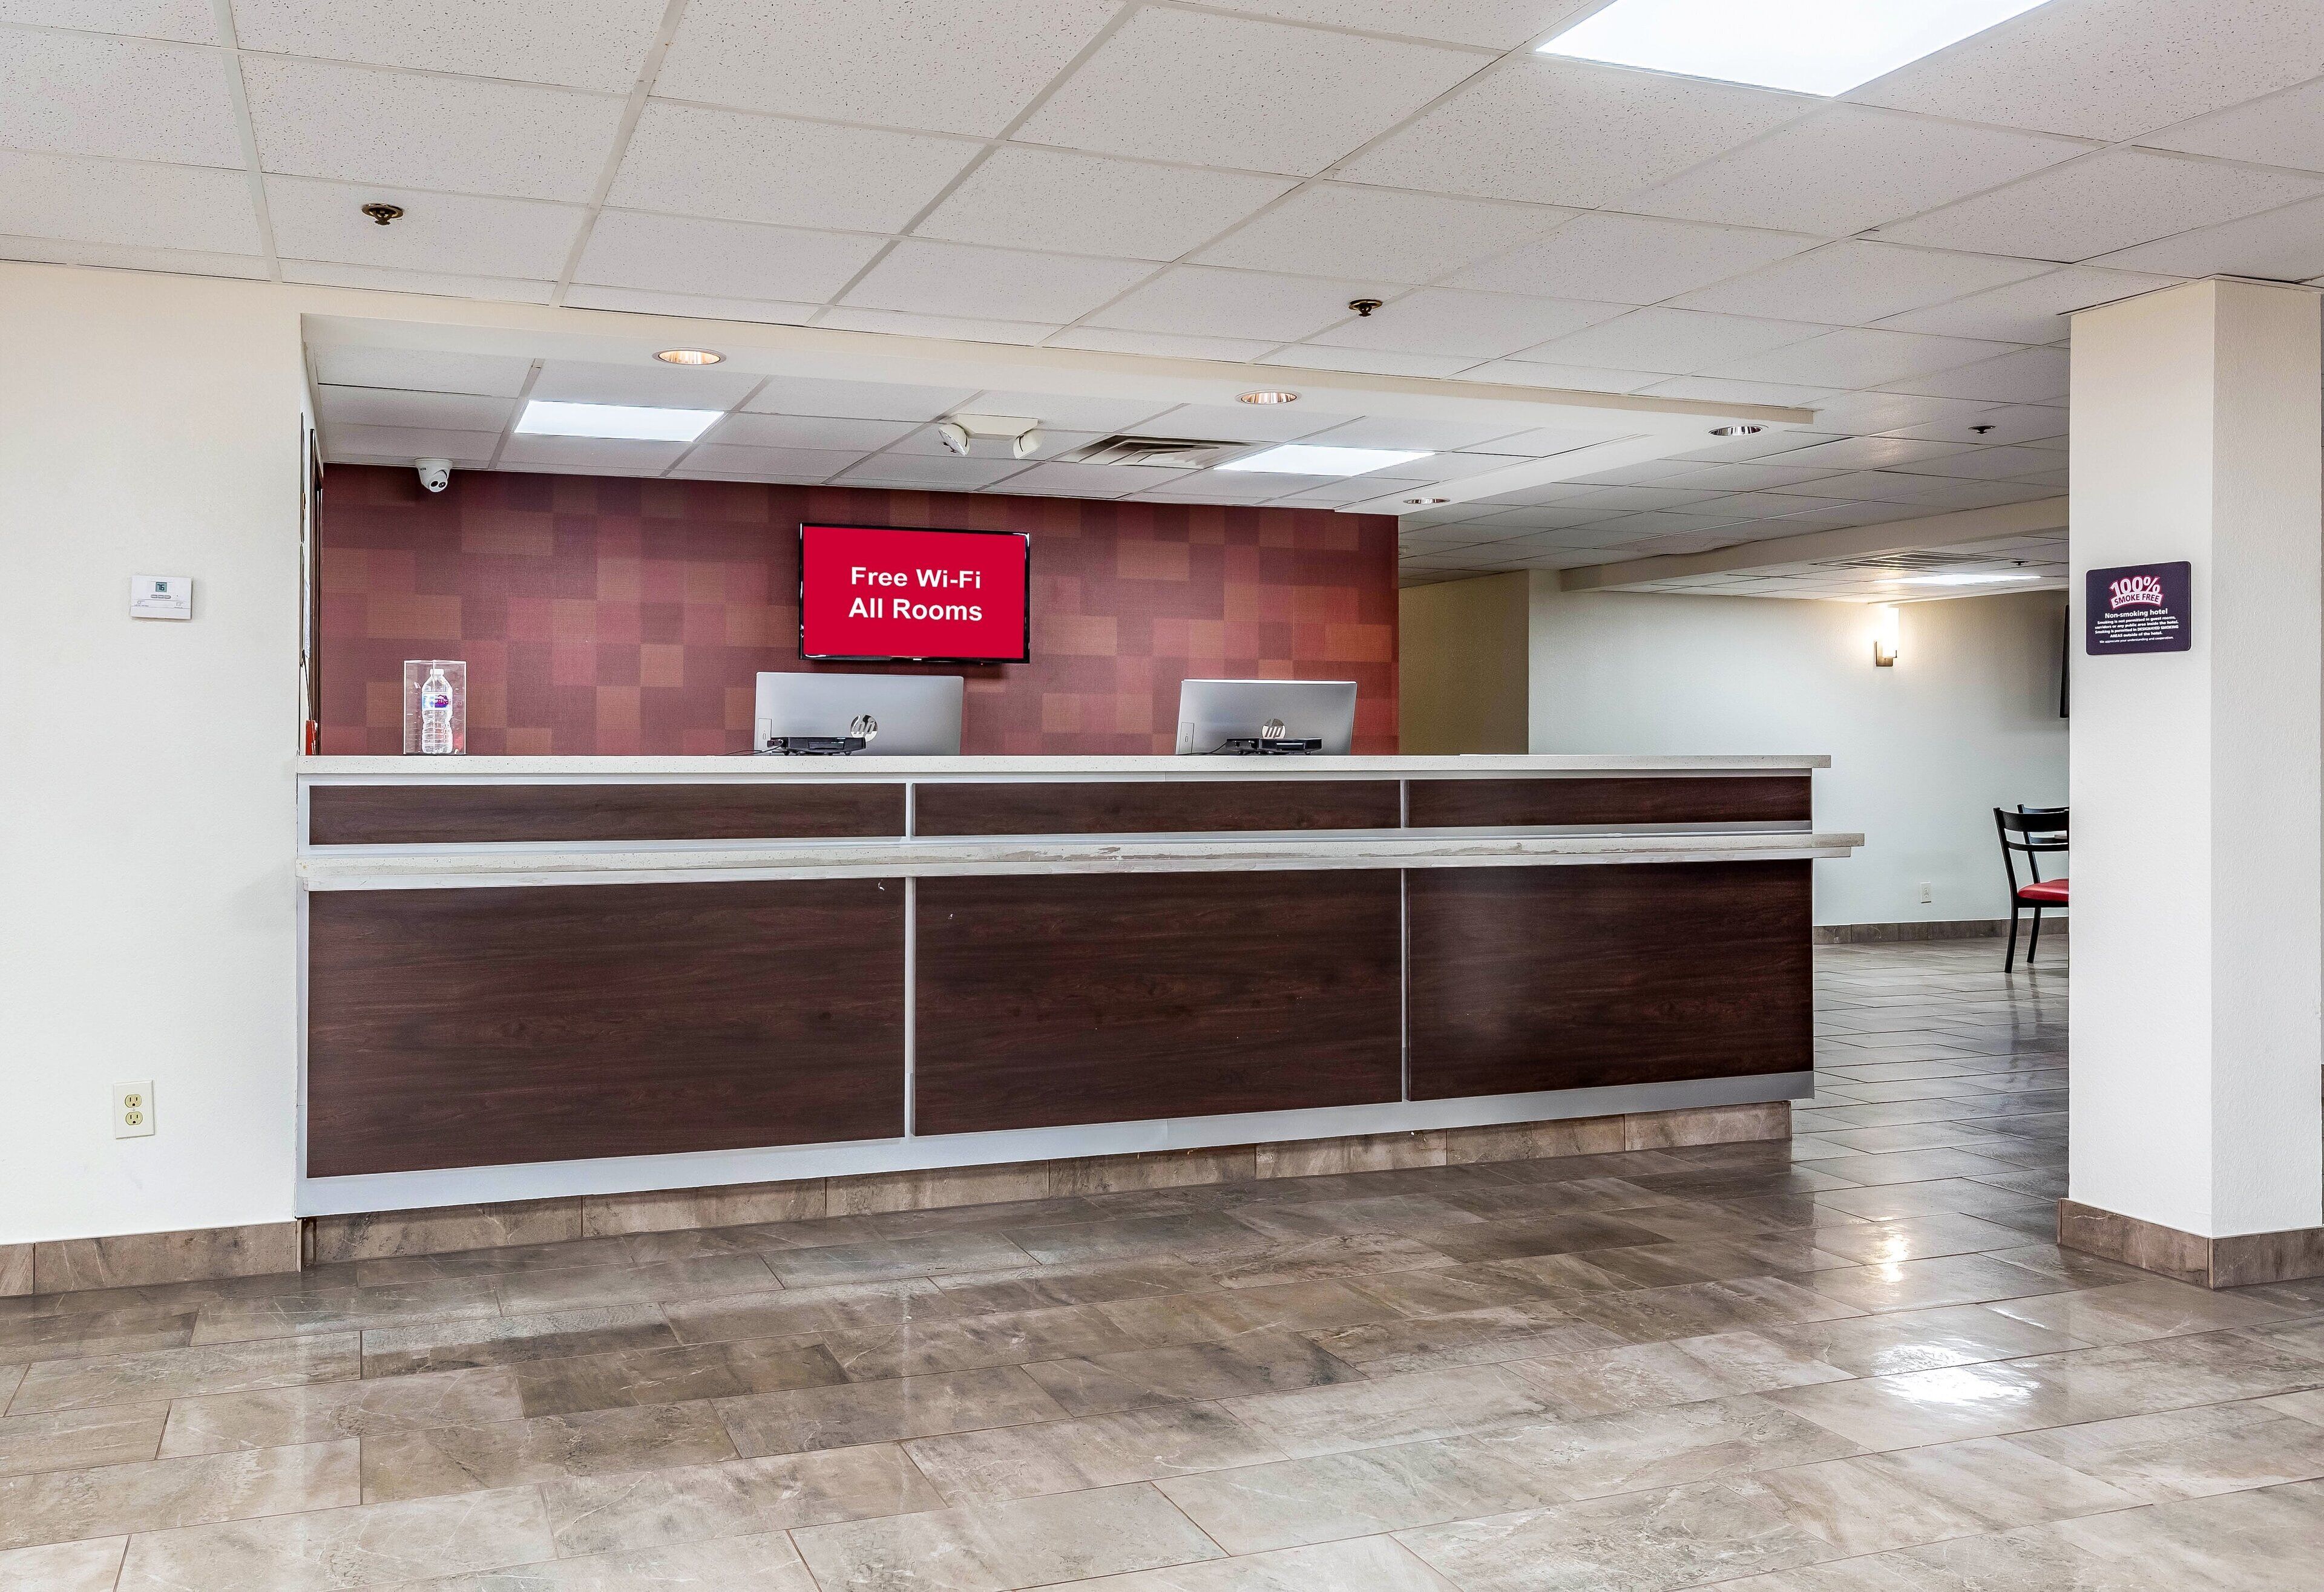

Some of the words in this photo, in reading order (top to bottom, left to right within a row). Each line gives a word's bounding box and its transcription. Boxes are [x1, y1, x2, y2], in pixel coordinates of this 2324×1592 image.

[851, 566, 908, 587] Free
[916, 569, 981, 589] Wi-Fi
[2110, 576, 2160, 596] 100%
[849, 597, 883, 618] All
[893, 598, 983, 621] Rooms
[2114, 594, 2141, 606] SMOKE
[2142, 594, 2160, 603] FREE
[2105, 610, 2148, 618] Non-smoking
[852, 714, 876, 739] hp
[1262, 718, 1285, 739] hp
